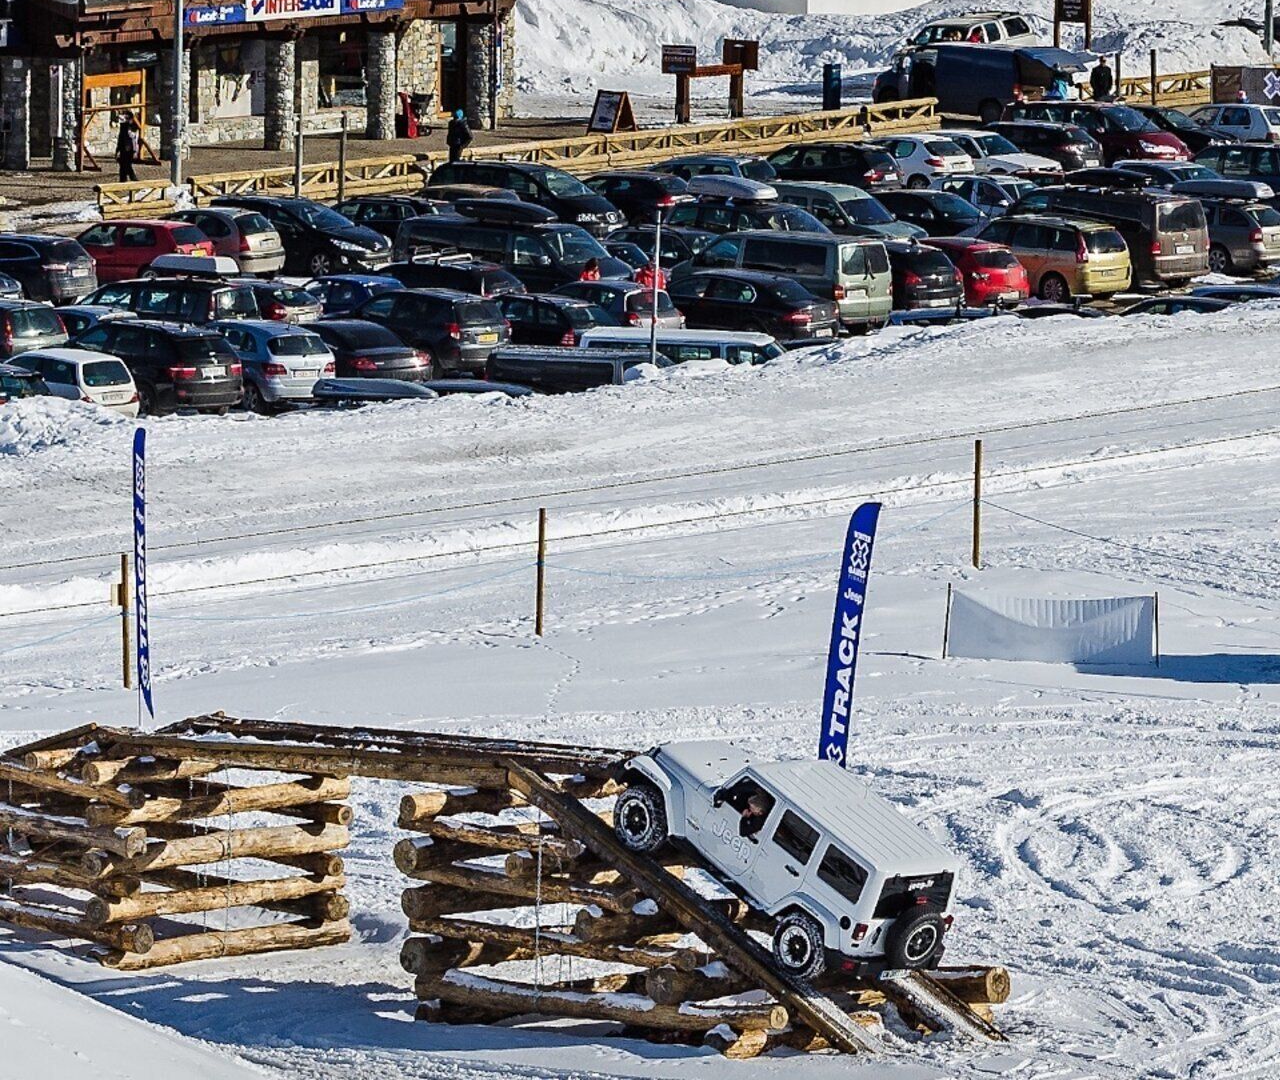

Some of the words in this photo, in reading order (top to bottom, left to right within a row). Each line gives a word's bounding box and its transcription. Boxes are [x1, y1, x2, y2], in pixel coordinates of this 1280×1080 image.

[844, 587, 863, 605] Jeep
[829, 611, 859, 737] TRACK
[712, 818, 751, 860] Jeep
